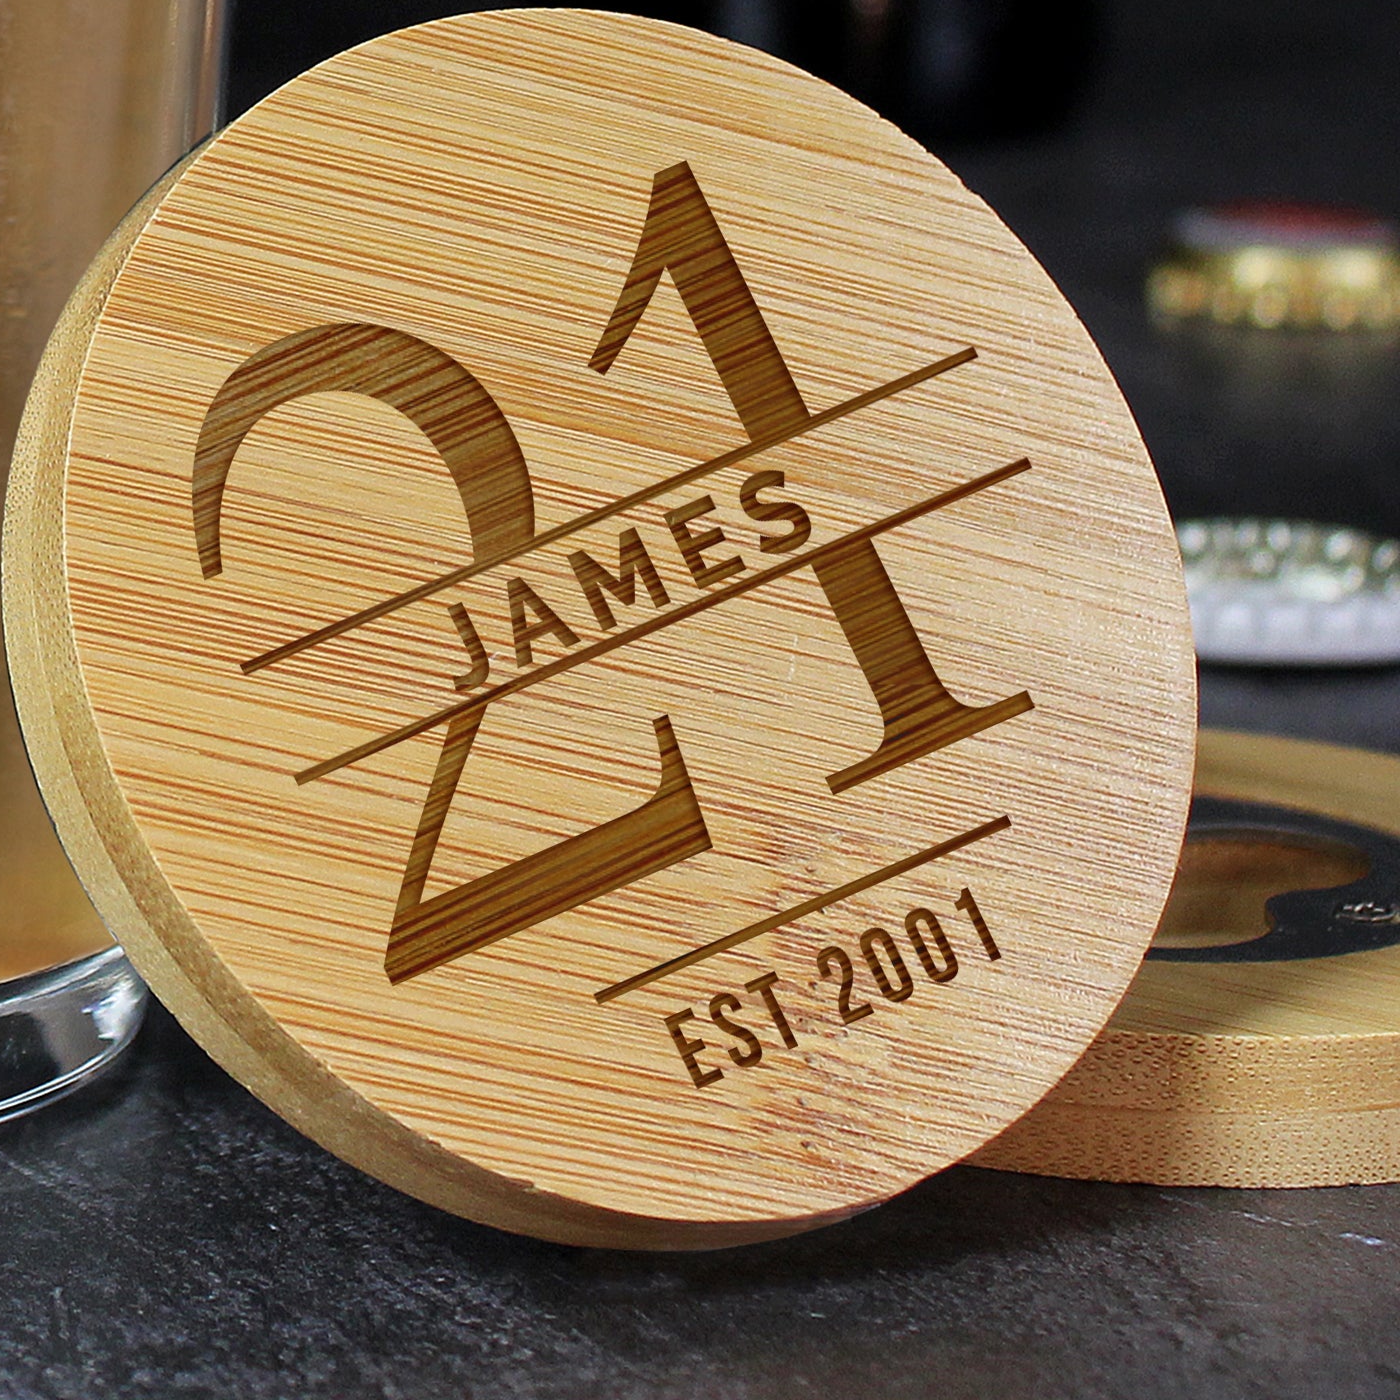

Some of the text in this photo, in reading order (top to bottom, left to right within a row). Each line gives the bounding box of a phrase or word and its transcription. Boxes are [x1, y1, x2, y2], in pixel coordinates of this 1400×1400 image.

[192, 160, 1035, 986] 21
[447, 470, 812, 692] JAMES
[663, 887, 1001, 1089] EST 2001
